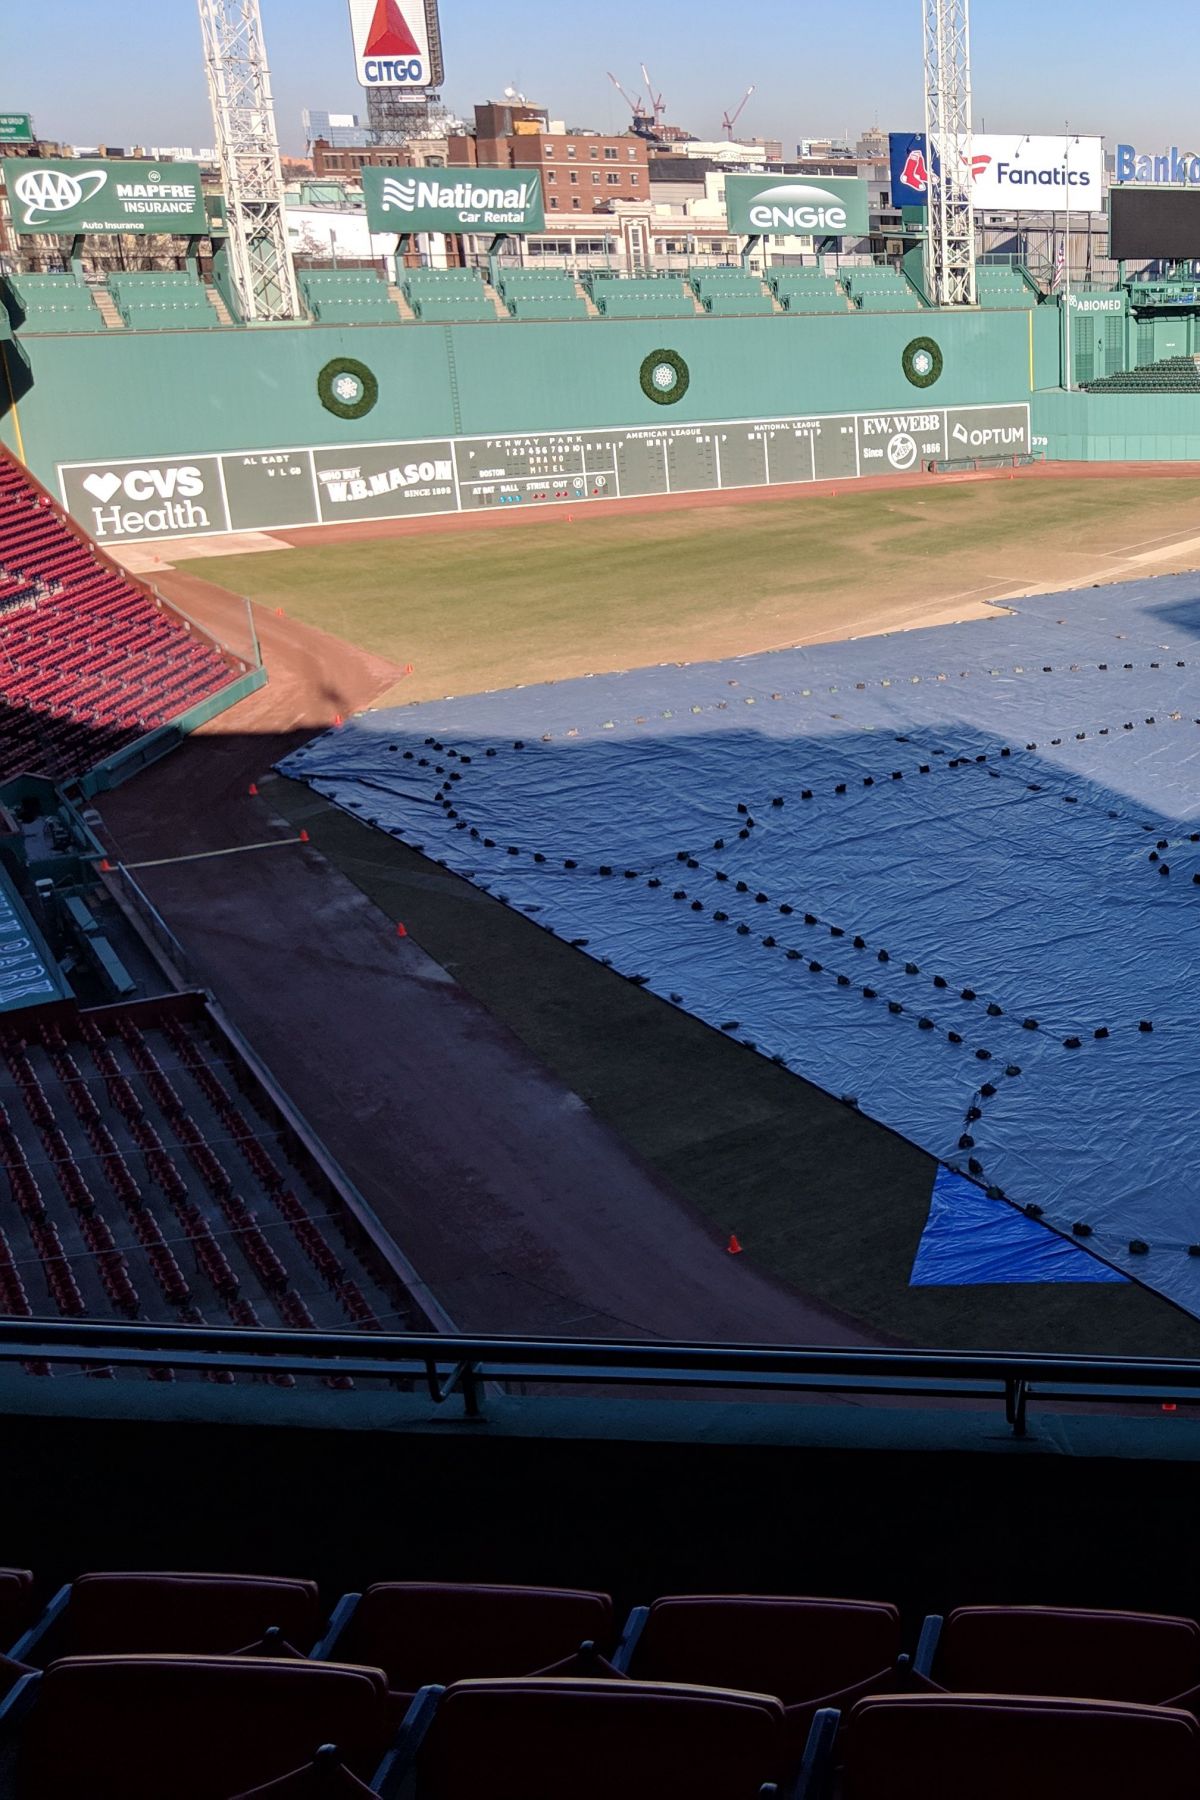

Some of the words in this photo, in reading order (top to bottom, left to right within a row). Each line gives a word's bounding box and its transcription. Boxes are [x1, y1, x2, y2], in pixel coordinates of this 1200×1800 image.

[365, 59, 422, 82] CITGO
[1116, 144, 1186, 183] Bank
[997, 162, 1091, 186] Fanatics
[24, 172, 75, 209] AAA
[116, 184, 196, 198] MAPFRE
[124, 202, 195, 213] INSURANCE
[458, 211, 481, 223] Car
[484, 211, 525, 223] Rental
[82, 221, 103, 230] Auto
[105, 221, 145, 230] Insurance
[1077, 300, 1121, 312] ABIOMED
[754, 423, 790, 432] NATIONAL
[792, 421, 821, 429] LEAGUE
[863, 417, 893, 436] F.W.
[894, 414, 940, 432] WEBB
[626, 430, 667, 440] AMERICAN
[671, 428, 701, 437] LEAGUE
[969, 427, 1025, 446] OPTUM
[486, 438, 540, 449] FENWAY
[549, 435, 583, 445] PARK
[1031, 437, 1048, 446] 379
[863, 447, 884, 459] Since
[243, 457, 258, 466] AL
[261, 454, 291, 465] EAST
[317, 470, 342, 482] WHO
[342, 468, 362, 480] BUT
[479, 468, 505, 478] BOSTON
[123, 466, 204, 501] CVS
[500, 484, 519, 493] BALL
[526, 482, 550, 491] STRIKE
[552, 480, 568, 489] OUT
[404, 488, 431, 498] SINCE
[92, 500, 211, 536] Health
